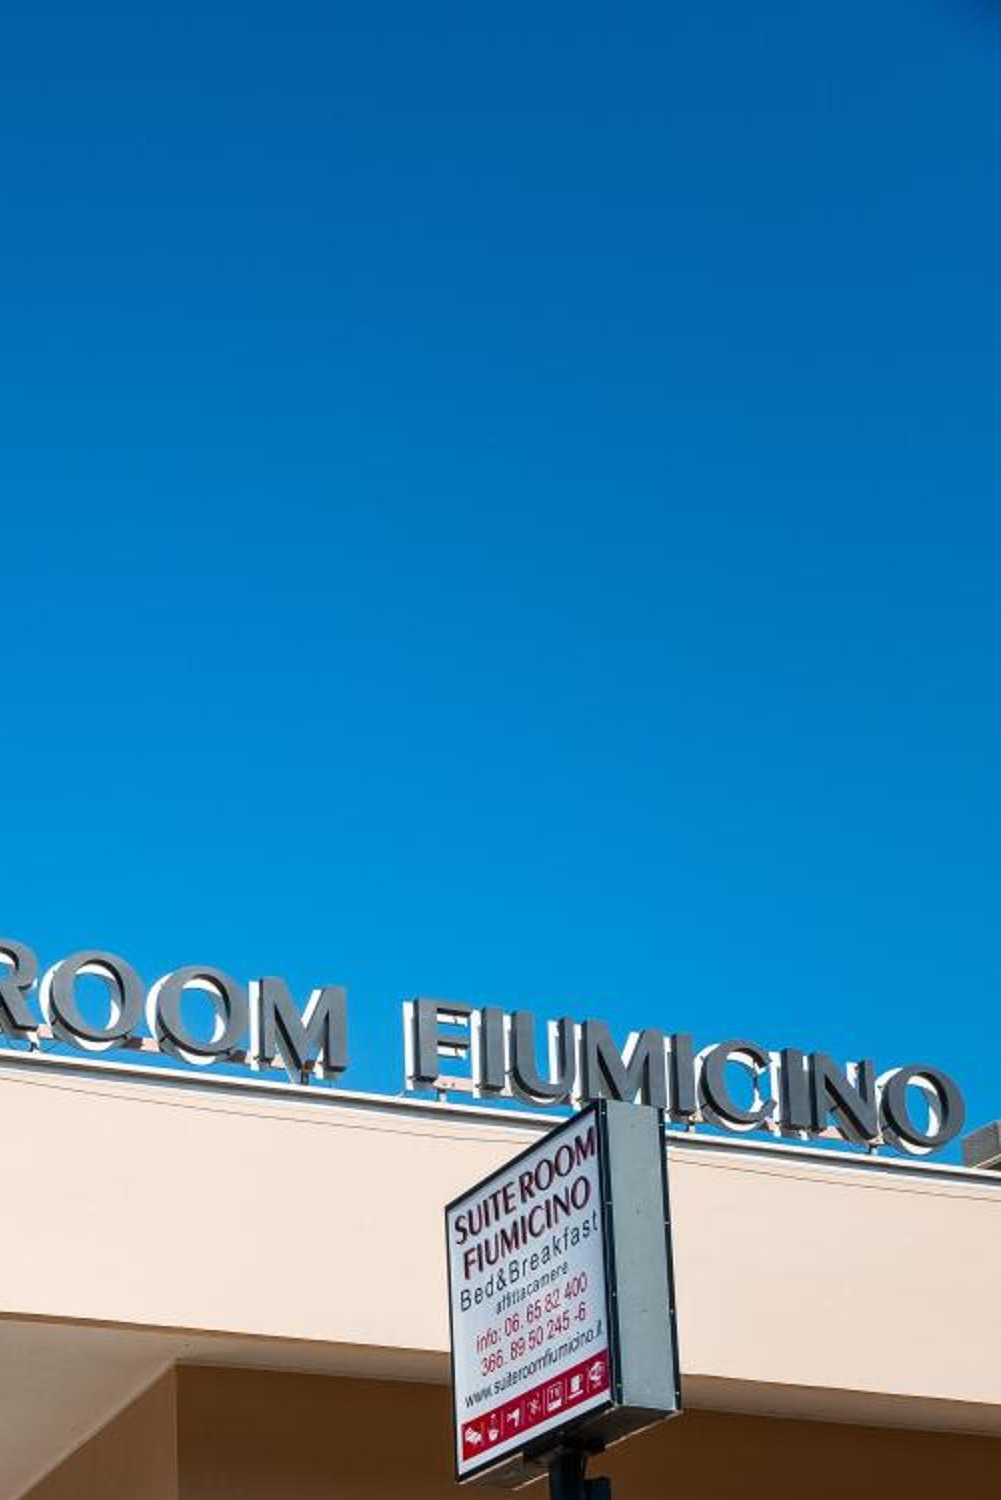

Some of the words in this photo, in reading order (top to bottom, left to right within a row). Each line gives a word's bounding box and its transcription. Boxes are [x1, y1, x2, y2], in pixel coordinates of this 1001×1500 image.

[402, 997, 967, 1156] FIUMICINO
[454, 1181, 518, 1246] SUITE
[518, 1125, 597, 1204] ROOM
[463, 1175, 591, 1281] FIUMICINO
[459, 1208, 599, 1313] Bed&Breakfast
[475, 1326, 502, 1354] info:
[526, 1299, 542, 1323] 65
[544, 1287, 561, 1313] 82
[564, 1271, 589, 1300] 400
[510, 1337, 526, 1361] 89
[528, 1325, 544, 1351] 50
[546, 1310, 570, 1340] 245
